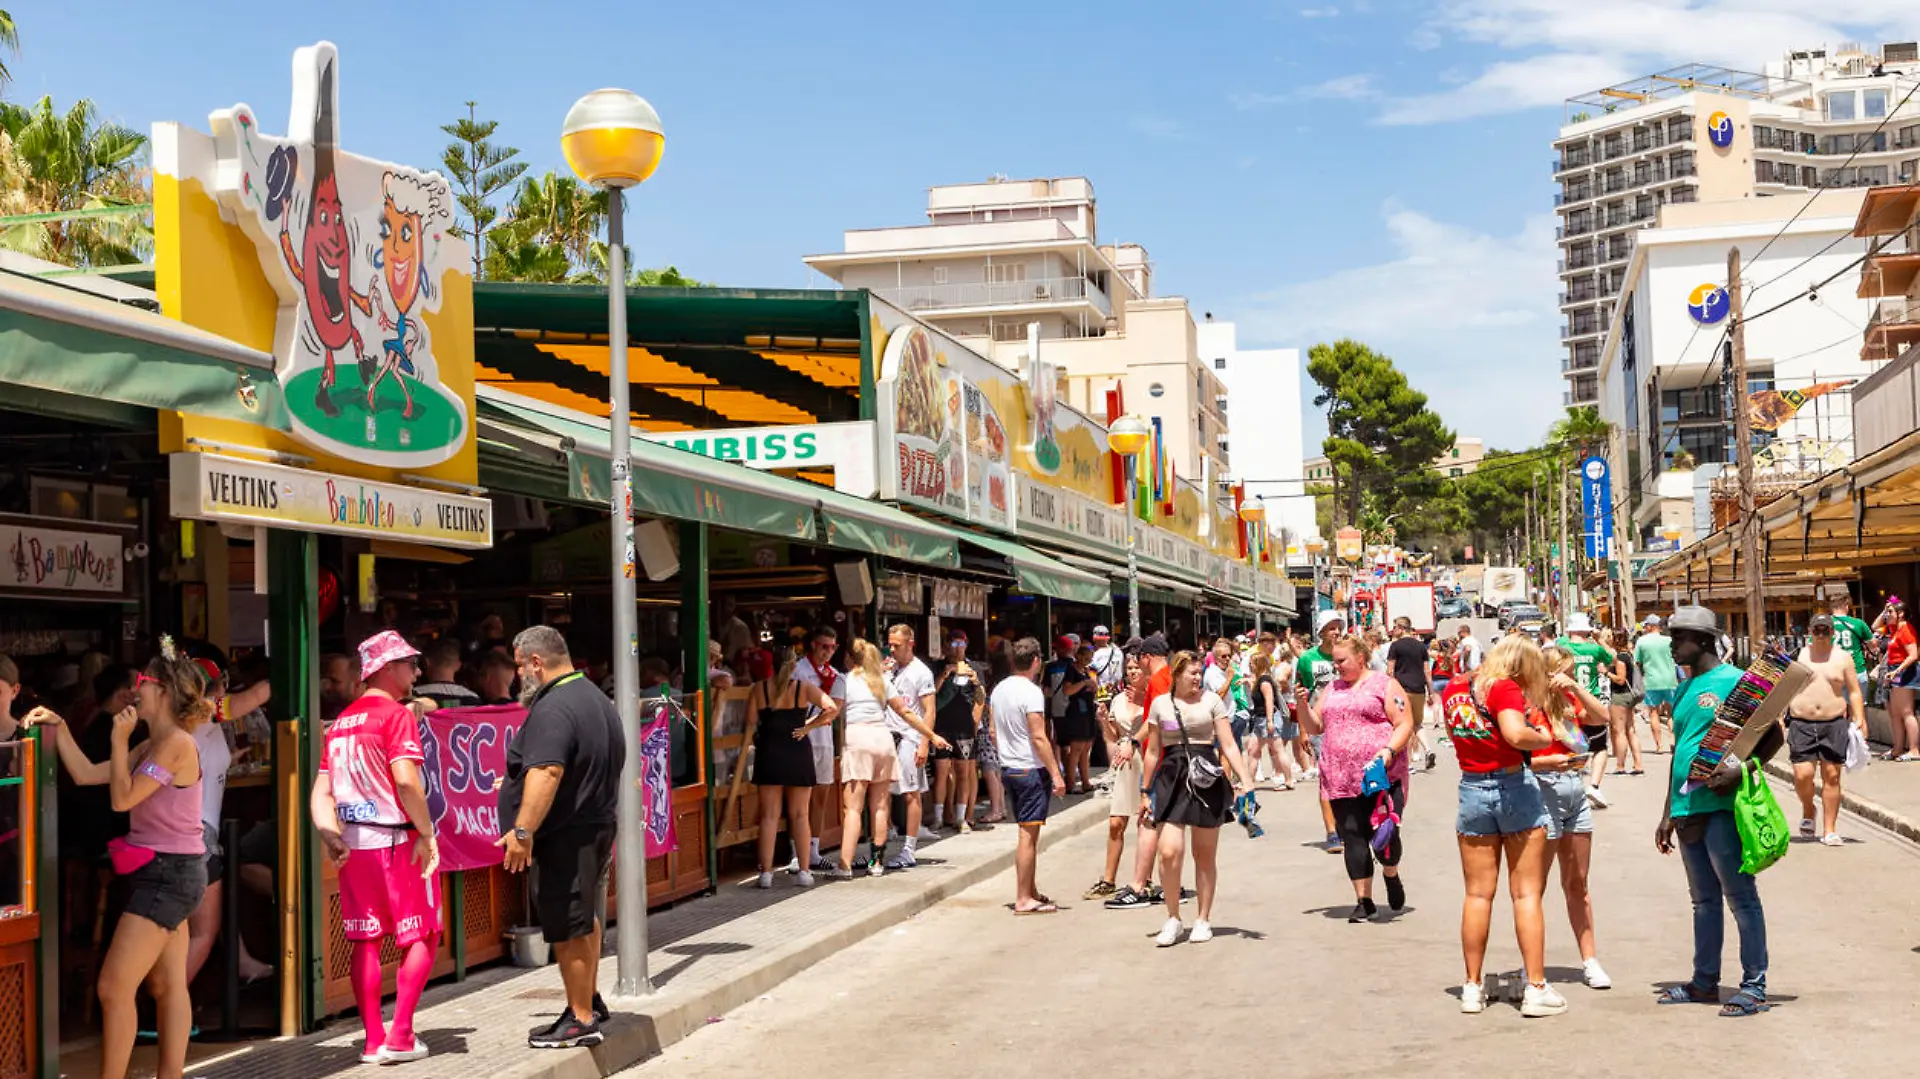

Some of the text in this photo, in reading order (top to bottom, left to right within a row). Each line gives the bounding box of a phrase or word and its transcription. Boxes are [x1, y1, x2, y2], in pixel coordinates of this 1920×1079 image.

[660, 432, 816, 461] MBISS
[899, 442, 946, 506] PIZZA
[208, 471, 279, 509] VELTINS
[325, 478, 394, 528] Bamboleo
[437, 503, 485, 533] VELTINS
[448, 722, 498, 795] SC
